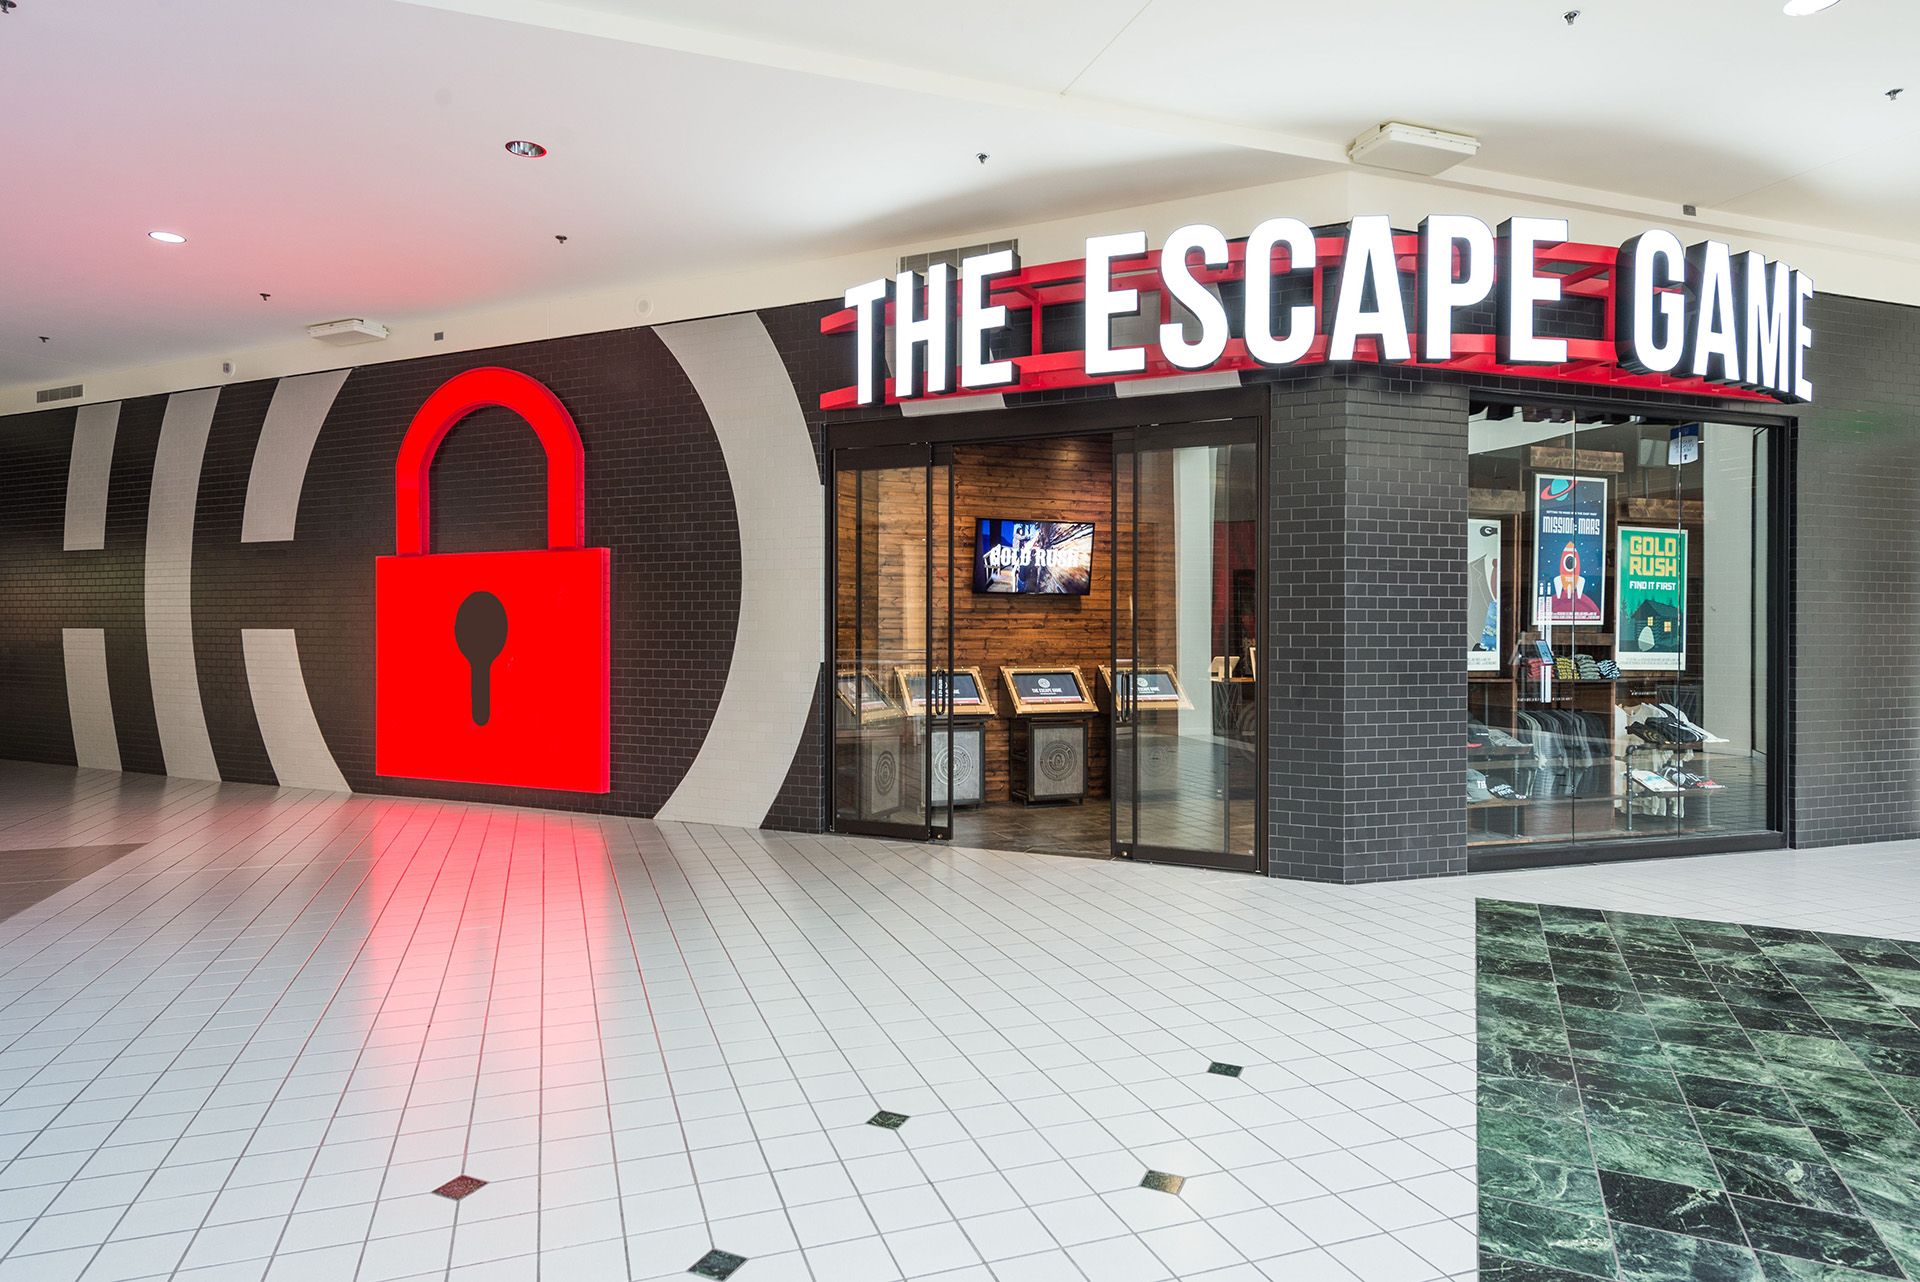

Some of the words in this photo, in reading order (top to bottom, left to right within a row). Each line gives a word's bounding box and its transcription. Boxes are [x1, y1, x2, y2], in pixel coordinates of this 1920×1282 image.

[845, 249, 1017, 405] THE
[1085, 214, 1569, 376] ESCAPE
[1622, 229, 1814, 403] GAME
[1578, 517, 1600, 535] MARS
[1630, 536, 1677, 556] GOLD
[1629, 556, 1677, 577] RUSH
[1629, 580, 1647, 590] FIND
[1648, 581, 1655, 590] IT
[1656, 582, 1677, 591] FIRST
